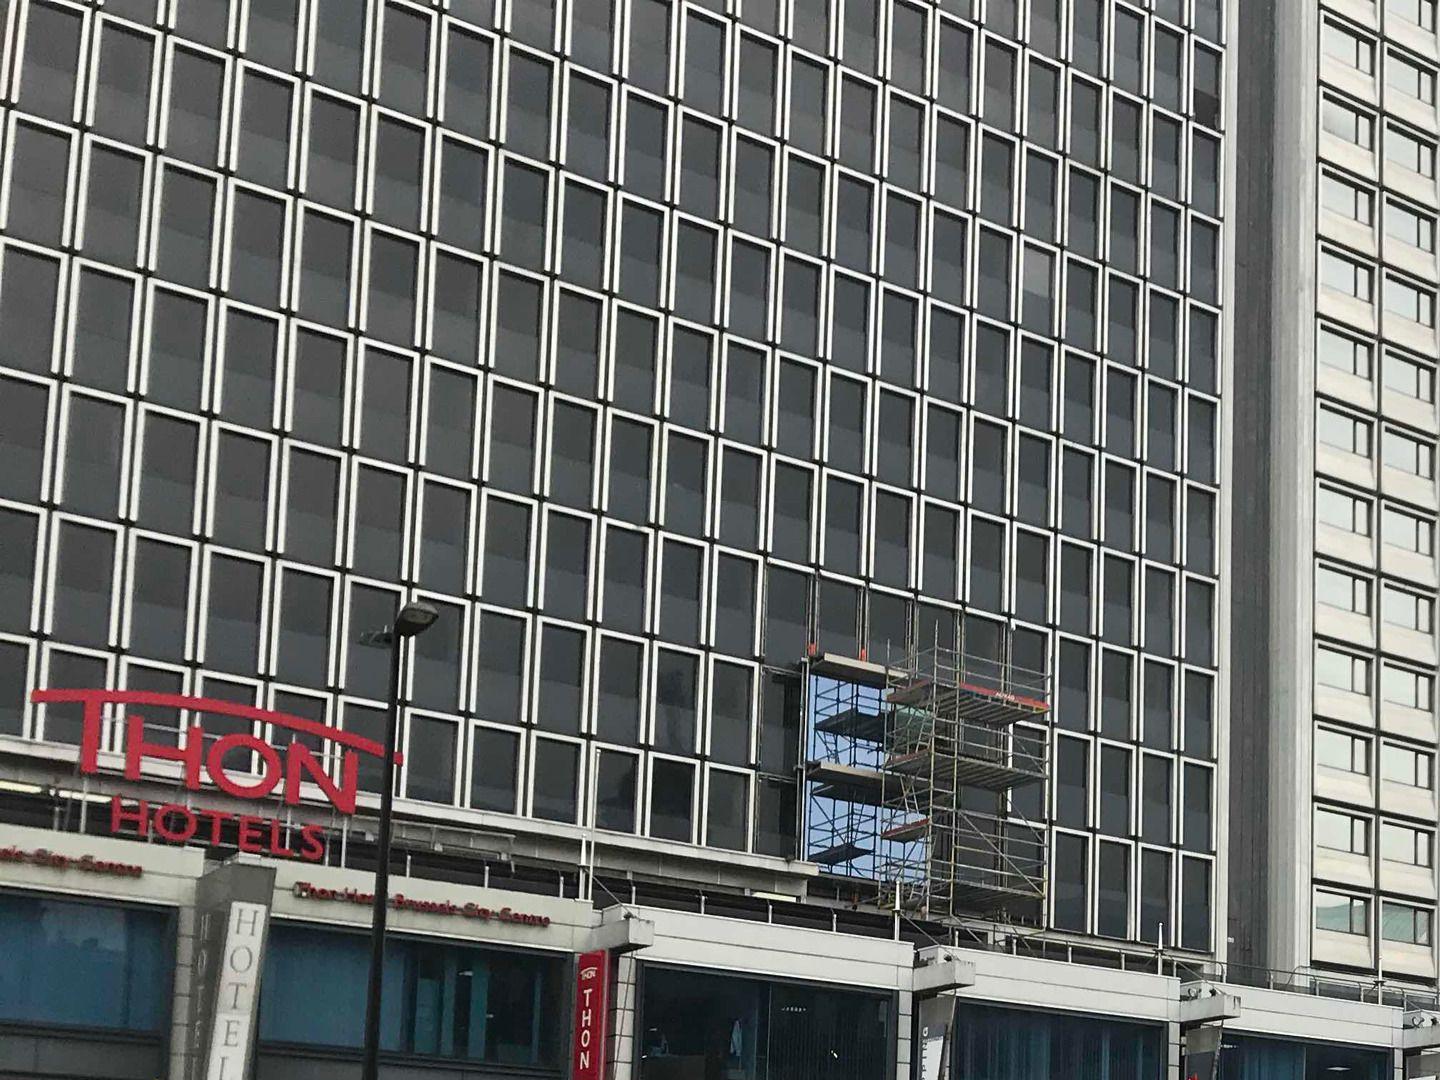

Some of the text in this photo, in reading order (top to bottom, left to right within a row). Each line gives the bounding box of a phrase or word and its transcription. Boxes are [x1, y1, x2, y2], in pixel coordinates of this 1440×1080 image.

[31, 688, 403, 815] THON
[110, 794, 326, 862] HOTELS
[579, 989, 593, 1070] THON
